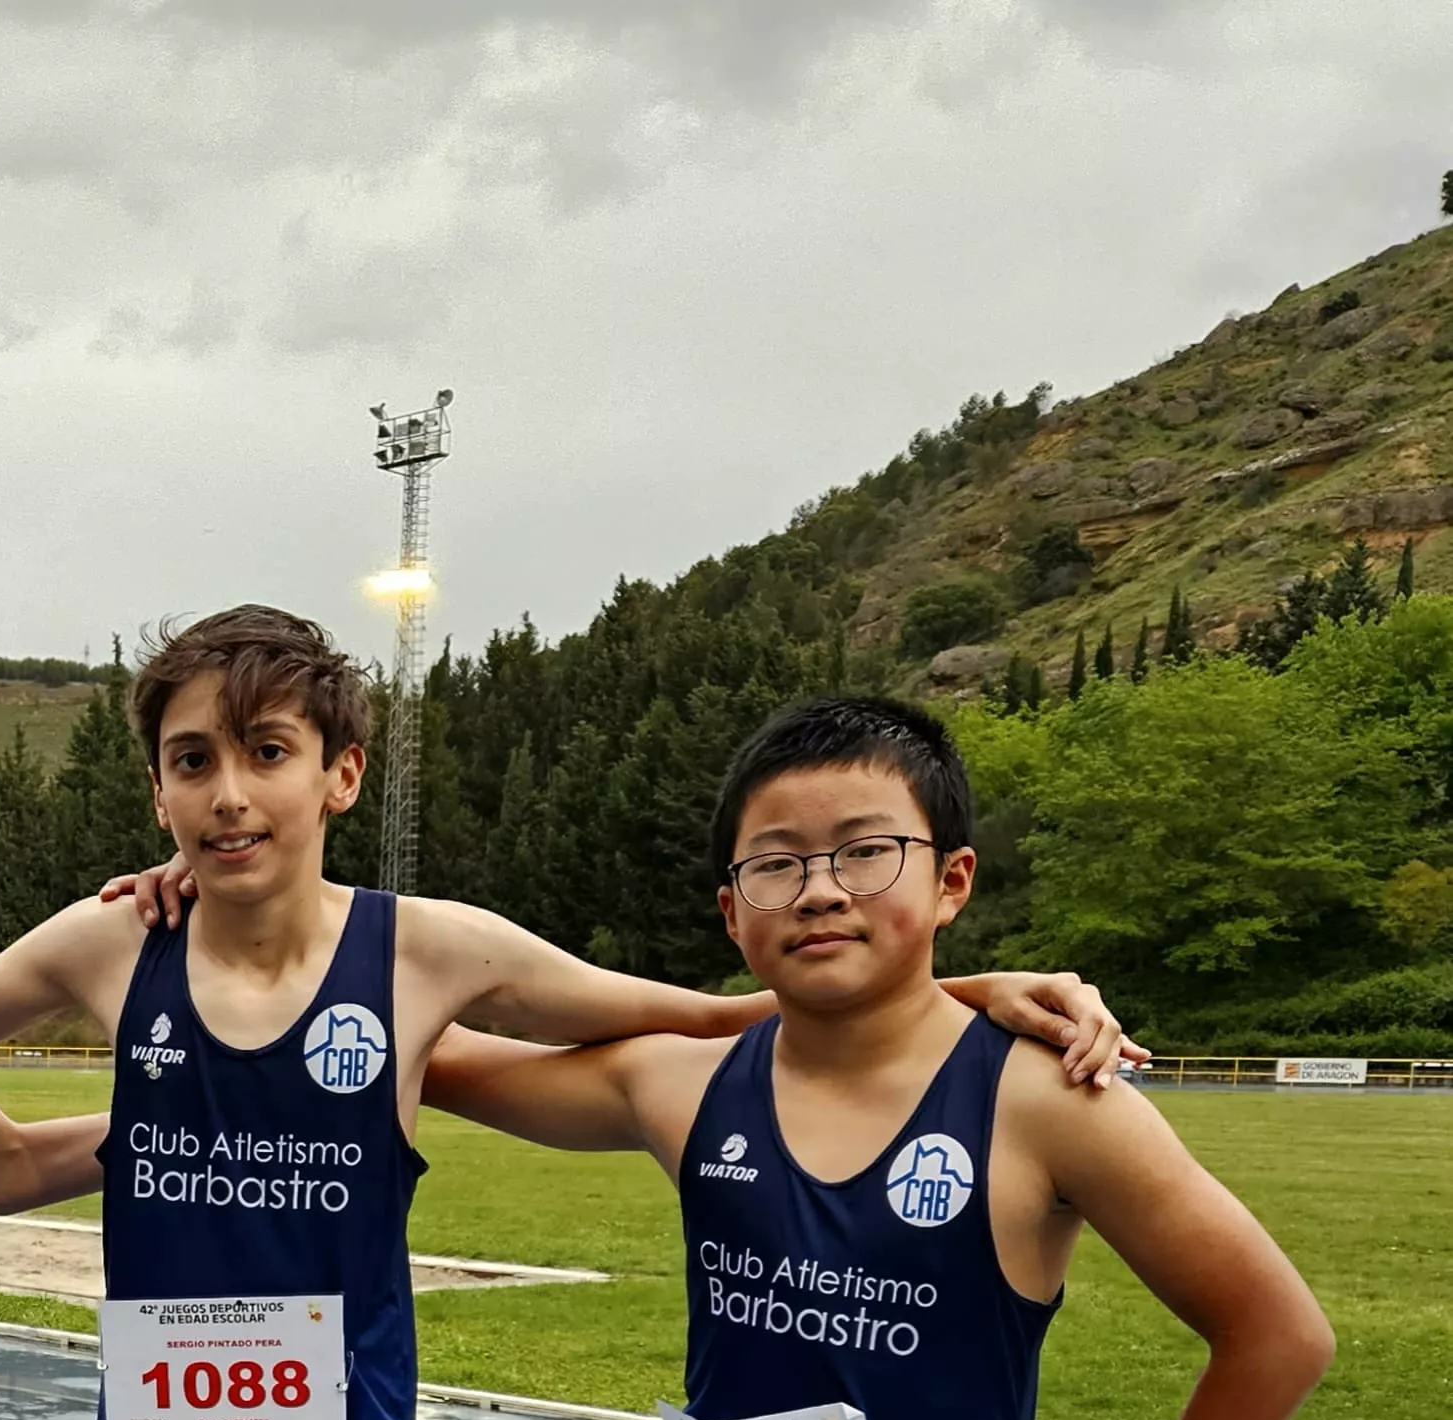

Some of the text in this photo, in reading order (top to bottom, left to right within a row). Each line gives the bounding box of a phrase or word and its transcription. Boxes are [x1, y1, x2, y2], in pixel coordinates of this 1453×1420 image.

[131, 1045, 185, 1064] VIATOR
[322, 1048, 367, 1087] CAB
[1303, 1063, 1352, 1071] GOBIERNO
[130, 1123, 362, 1166] Club Atletismo
[134, 1159, 349, 1212] Barbastro
[699, 1162, 758, 1183] VIATOR
[902, 1179, 951, 1221] CAB
[700, 1241, 937, 1307] Club Atletismo
[159, 1313, 265, 1324] EN EDAD ESCOLAR
[161, 1303, 207, 1314] JUEGOS
[209, 1302, 284, 1313] DEPORTIVOS
[709, 1277, 919, 1356] Barbastro
[166, 1339, 282, 1349] SERGIO PINTADO PERA
[142, 1360, 311, 1409] 1088
